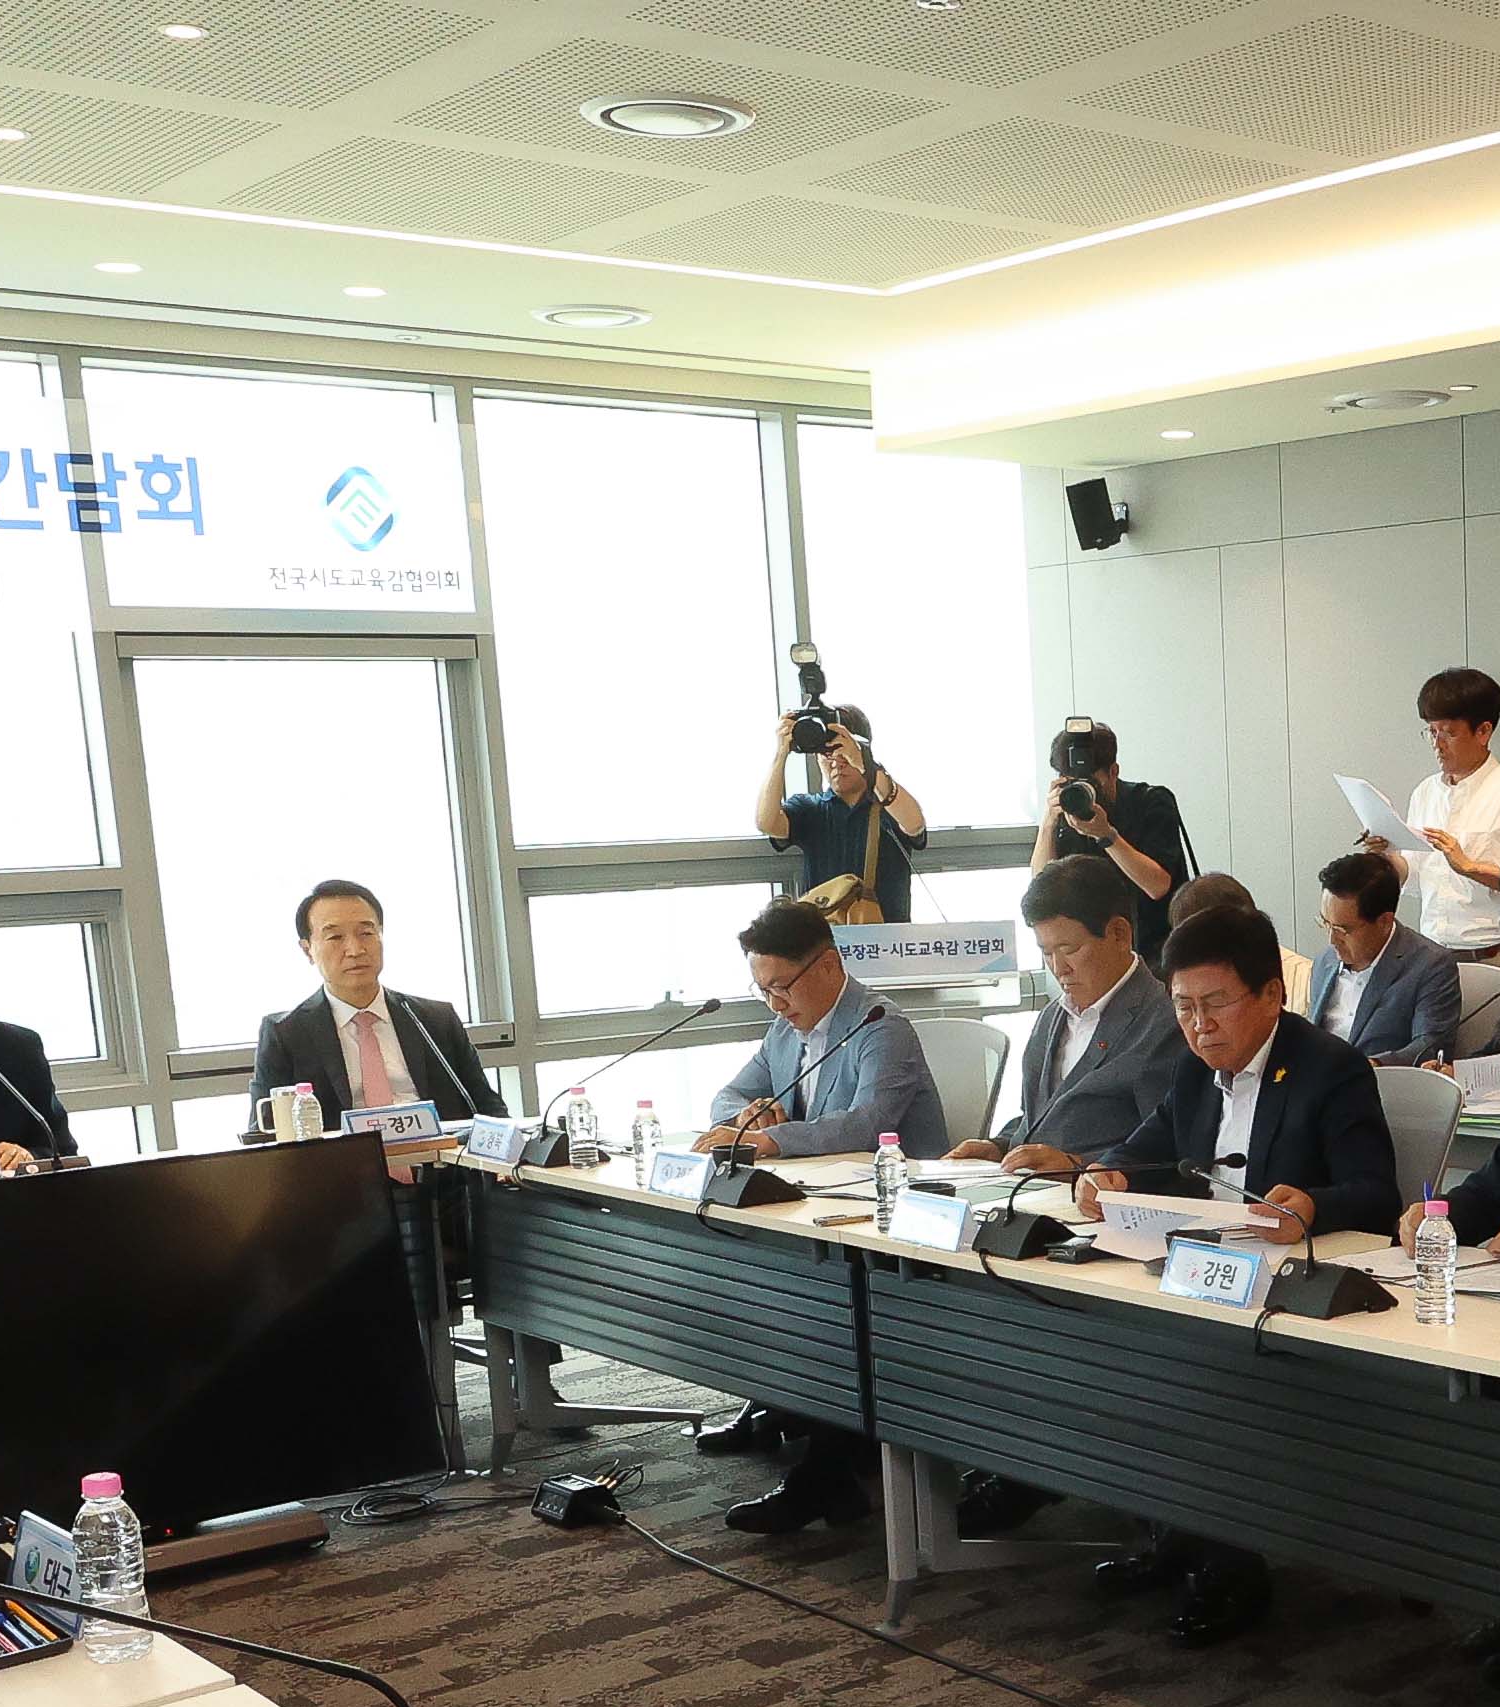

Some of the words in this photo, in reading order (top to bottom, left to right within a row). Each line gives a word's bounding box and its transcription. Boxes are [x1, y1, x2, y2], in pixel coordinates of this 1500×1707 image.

[268, 565, 462, 595] 전국시도교육감협의회
[963, 938, 1005, 955] 간담회
[387, 1110, 423, 1136] 경기
[1202, 1258, 1237, 1294] 강원
[42, 1557, 75, 1601] 대구
